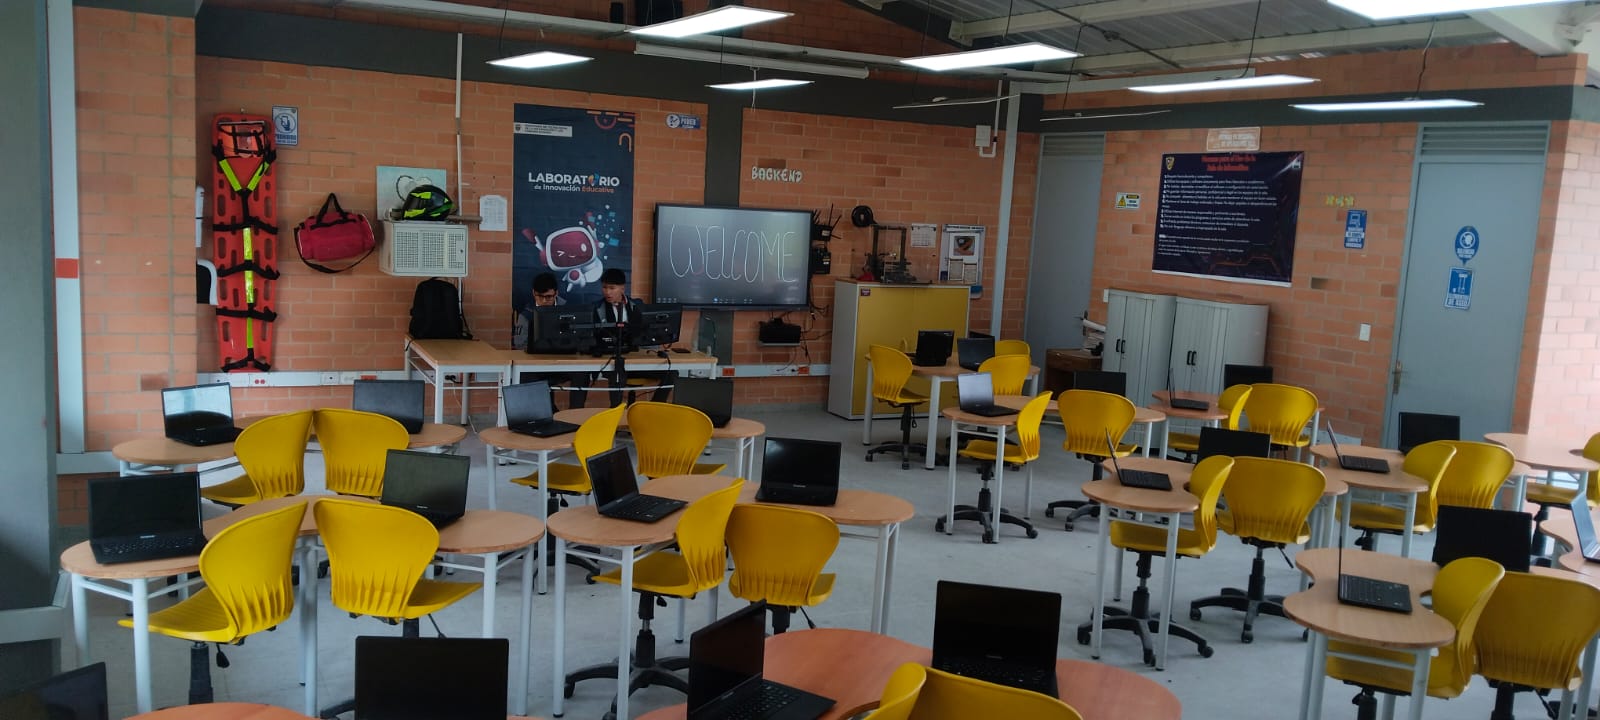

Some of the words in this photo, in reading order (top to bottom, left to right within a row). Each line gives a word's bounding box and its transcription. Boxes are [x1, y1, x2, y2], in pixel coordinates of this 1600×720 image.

[528, 172, 620, 187] LABORATORIO
[543, 184, 580, 192] Innovación
[669, 223, 797, 283] WELCOME
